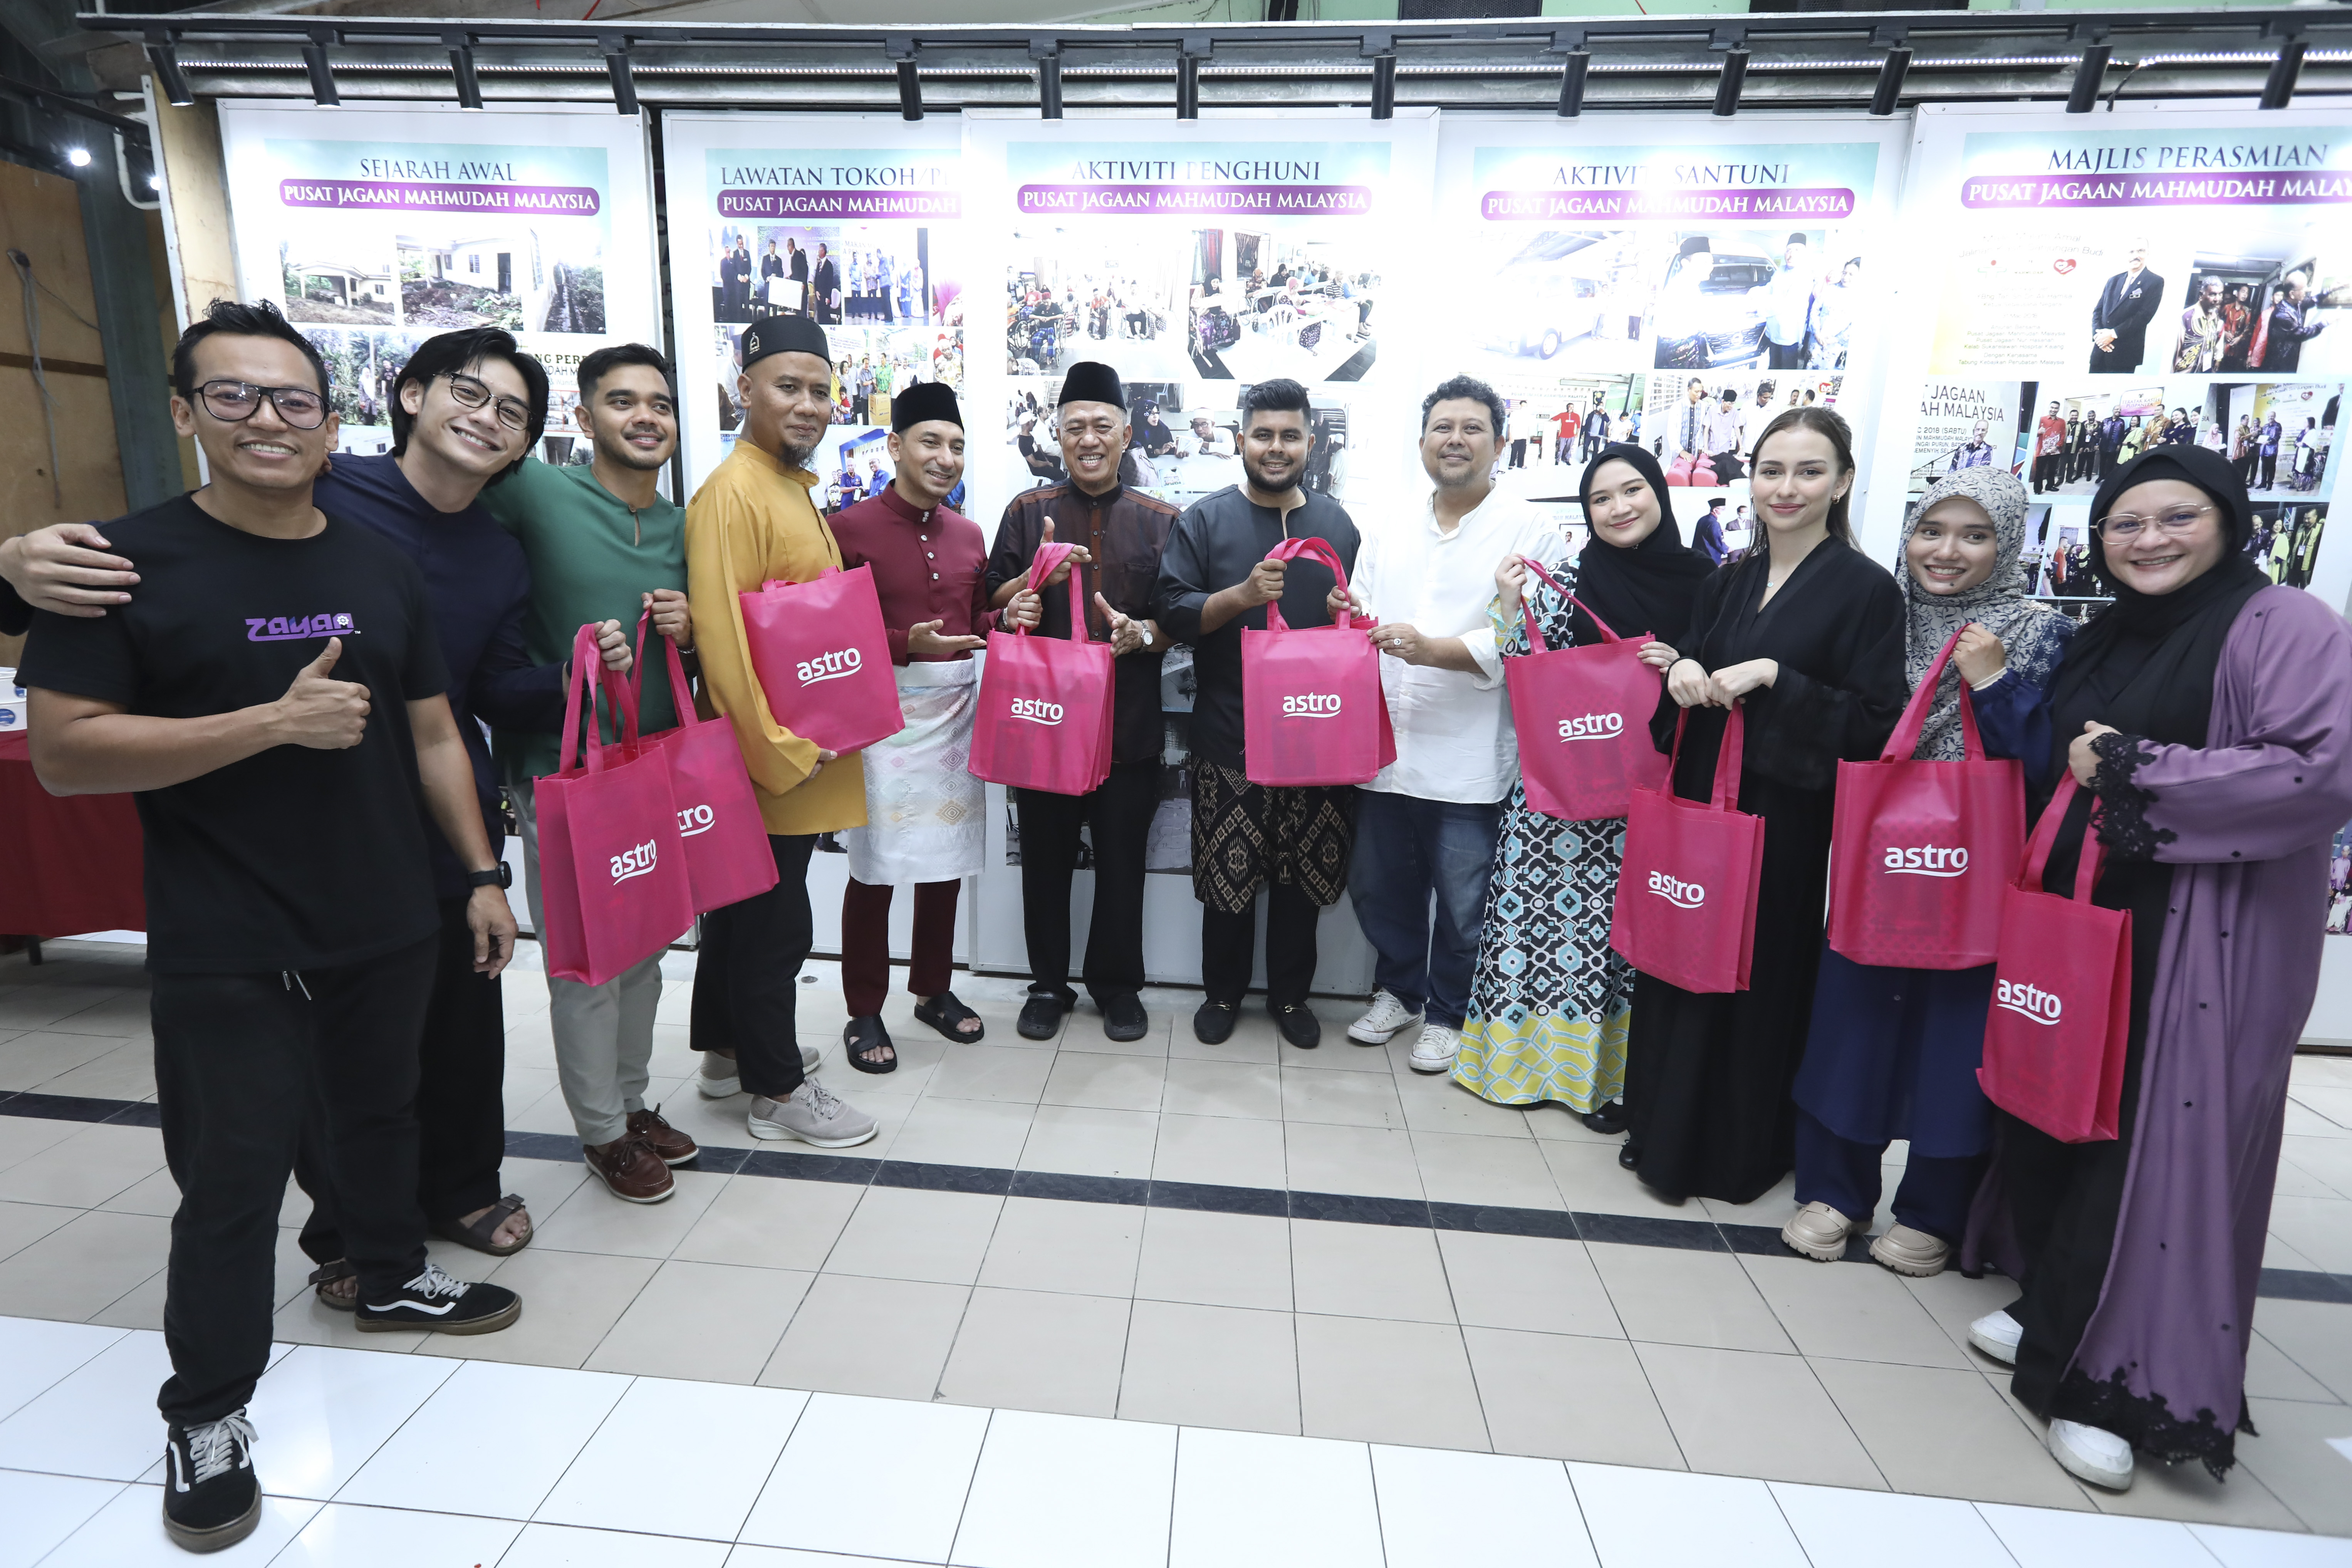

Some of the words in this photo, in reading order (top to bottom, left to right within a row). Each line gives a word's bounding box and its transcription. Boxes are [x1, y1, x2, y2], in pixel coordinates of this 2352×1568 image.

[360, 159, 451, 181] SEJARAH
[458, 162, 517, 181] AWAL
[2048, 147, 2147, 174] MAJLIS
[2158, 144, 2328, 169] PERASMIAN
[721, 167, 822, 185] LAWATAN
[1072, 161, 1175, 181] AKTIVITI
[1186, 161, 1320, 181] PENGHUNI
[1673, 164, 1790, 184] SANTUNI
[284, 185, 332, 202] PUSAT
[338, 186, 399, 206] JAGAAN
[405, 189, 509, 208] MAHMUDAH
[514, 192, 596, 210] MALAYSIA
[1023, 192, 1077, 207] PUSAT
[1081, 192, 1150, 211] JAGAAN
[1156, 193, 1270, 208] MAHMUDAH
[1276, 193, 1366, 209] MALAYSIA
[1968, 184, 2034, 201] PUSAT
[2039, 182, 2125, 205] JAGAAN
[2131, 180, 2276, 199] MAHMUDAH
[2280, 178, 2352, 196] MALAY
[723, 197, 774, 211] PUSAT
[778, 197, 842, 215] JAGAAN
[847, 197, 957, 213] MAHMUDAH
[1487, 198, 1544, 214] PUSAT
[1548, 197, 1621, 218] JAGAAN
[1626, 197, 1748, 213] MAHMUDAH
[1754, 196, 1848, 212] MALAYSIA
[2082, 247, 2104, 256] Budi
[1931, 385, 1985, 404] JAGAAN
[1944, 402, 2004, 421] MALAYSIA
[797, 648, 861, 681] astro
[1011, 698, 1064, 720] astro
[1283, 692, 1341, 713] astro
[1559, 713, 1623, 737] astro
[611, 839, 656, 878] astro
[1884, 844, 1968, 869] astro
[1649, 870, 1704, 902] astro
[1998, 979, 2062, 1018] astro
